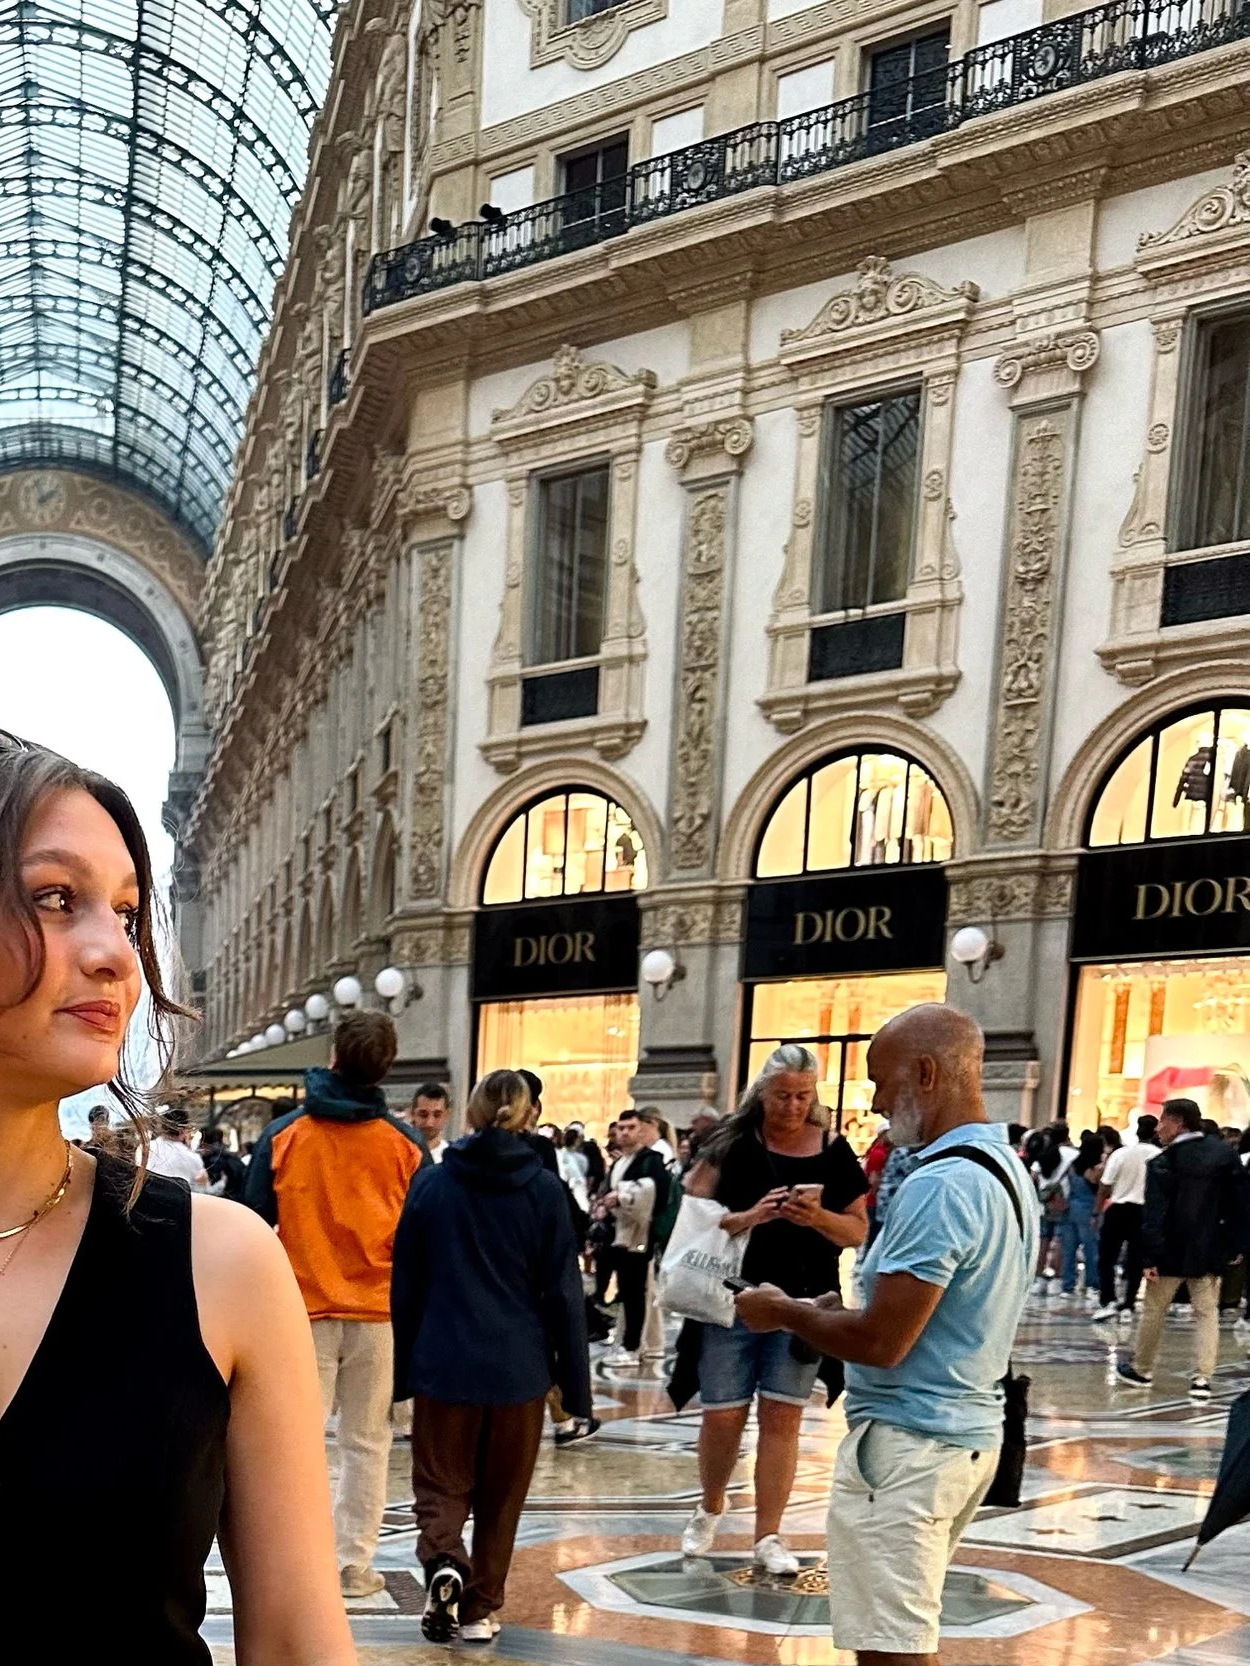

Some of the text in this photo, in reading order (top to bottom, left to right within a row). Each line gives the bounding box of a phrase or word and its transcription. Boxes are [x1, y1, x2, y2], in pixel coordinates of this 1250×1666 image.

[1131, 876, 1250, 920] DIOR
[792, 905, 895, 945] DIOR
[513, 930, 596, 967] DIOR
